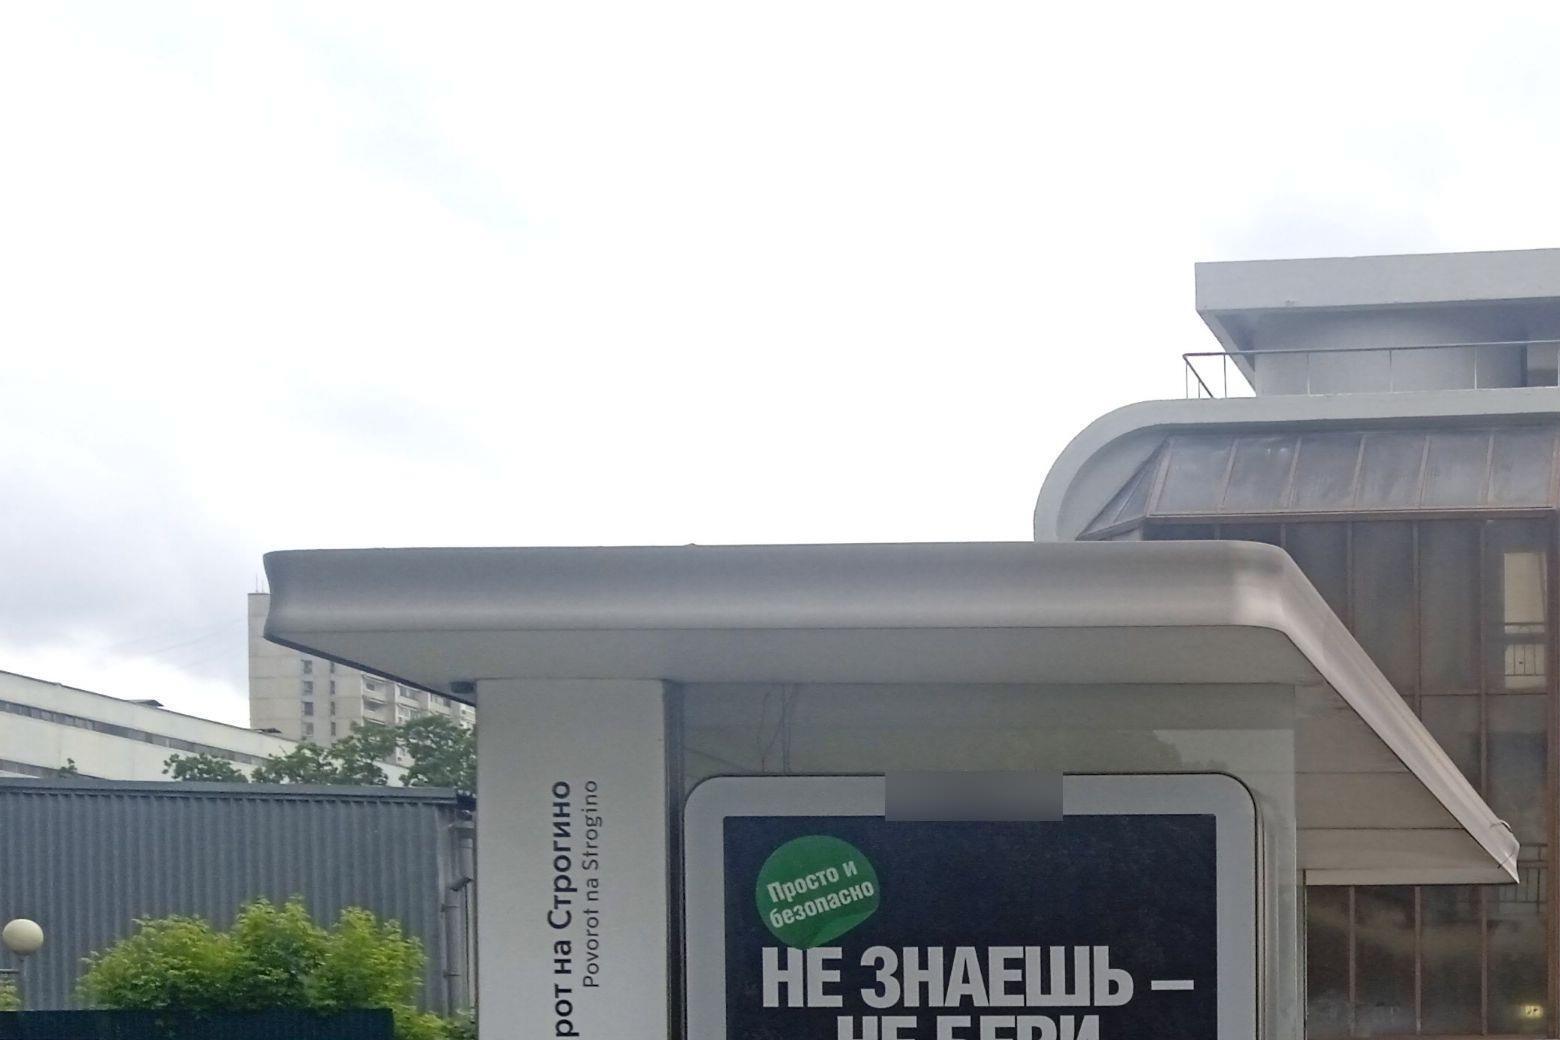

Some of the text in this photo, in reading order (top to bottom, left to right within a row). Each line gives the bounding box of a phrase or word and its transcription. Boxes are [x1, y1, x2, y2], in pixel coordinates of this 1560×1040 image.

[547, 781, 578, 930] Строгино
[767, 860, 858, 903] Просто и
[581, 780, 603, 988] Povorot na Strogino
[770, 881, 875, 928] безопасно
[553, 940, 573, 975] на
[762, 946, 843, 1008] НЕ
[860, 945, 1134, 1009] ЗНАЕШЬ
